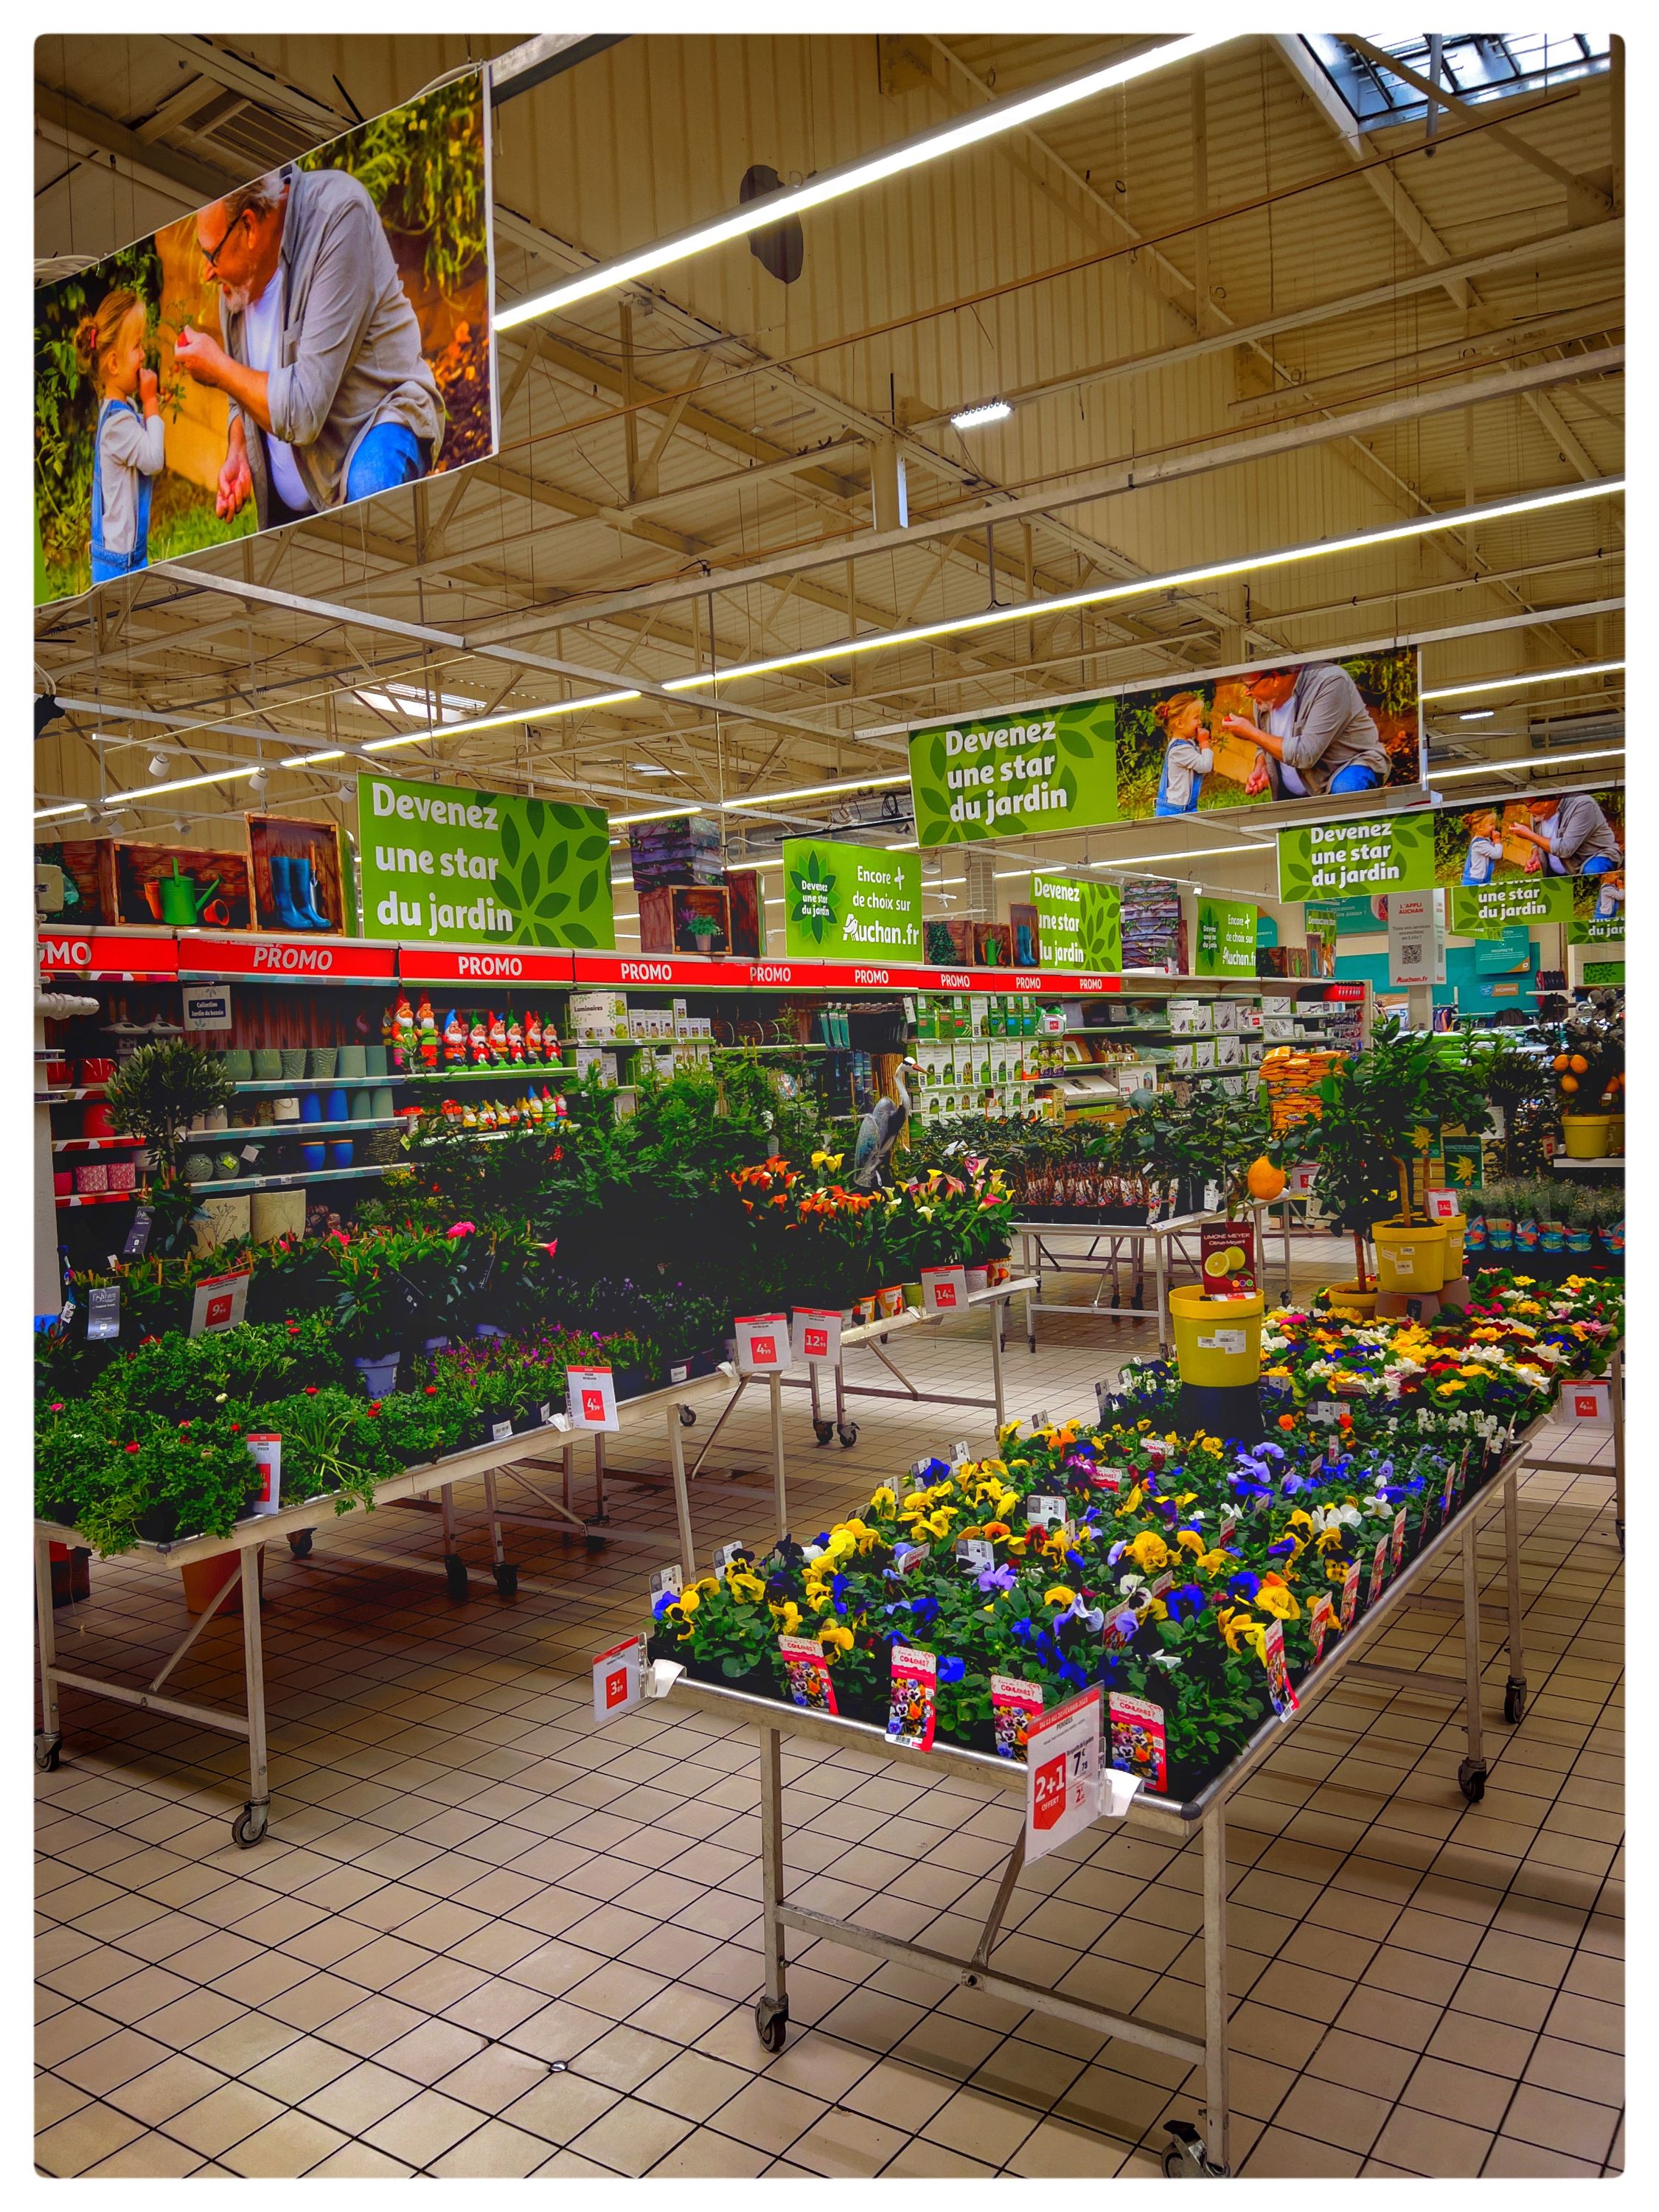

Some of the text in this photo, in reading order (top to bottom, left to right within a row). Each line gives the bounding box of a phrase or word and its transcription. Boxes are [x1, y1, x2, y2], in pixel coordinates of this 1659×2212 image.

[945, 720, 1057, 757] Devenez
[947, 754, 1056, 789] une star
[372, 782, 499, 831] Devenez
[950, 785, 1068, 827] du jardin
[1310, 822, 1392, 844] Devenez
[375, 845, 499, 881] une star
[1311, 843, 1392, 866] une star
[857, 865, 891, 885] Encore
[1311, 862, 1400, 889] du jardin
[801, 880, 828, 892] Devenez
[1034, 877, 1080, 902] Devenez
[1478, 886, 1540, 903] une star
[802, 894, 829, 905] une star
[852, 890, 911, 912] de choix sur
[377, 890, 513, 936] du jardin
[801, 904, 830, 918] du jardin
[1228, 914, 1245, 927] Encore
[1478, 900, 1547, 921] du jardin
[842, 913, 920, 946] Auchan.fr
[1057, 912, 1079, 933] star
[1587, 925, 1605, 936] du
[1225, 931, 1254, 944] de choix sur
[252, 947, 334, 971] PROMO
[1054, 939, 1085, 967] jardin
[458, 956, 523, 977] PROMO
[620, 962, 673, 981] PROMO
[749, 966, 792, 983] PROMO
[854, 970, 889, 984] PROMO
[940, 973, 971, 988] PROMO
[1015, 976, 1042, 990] PROMO
[1079, 978, 1103, 990] PROMO
[1396, 975, 1428, 984] Auchan.fr
[573, 1004, 603, 1012] Luminaires
[1035, 1764, 1065, 1804] 2+1
[1041, 1795, 1060, 1812] OFFERT
